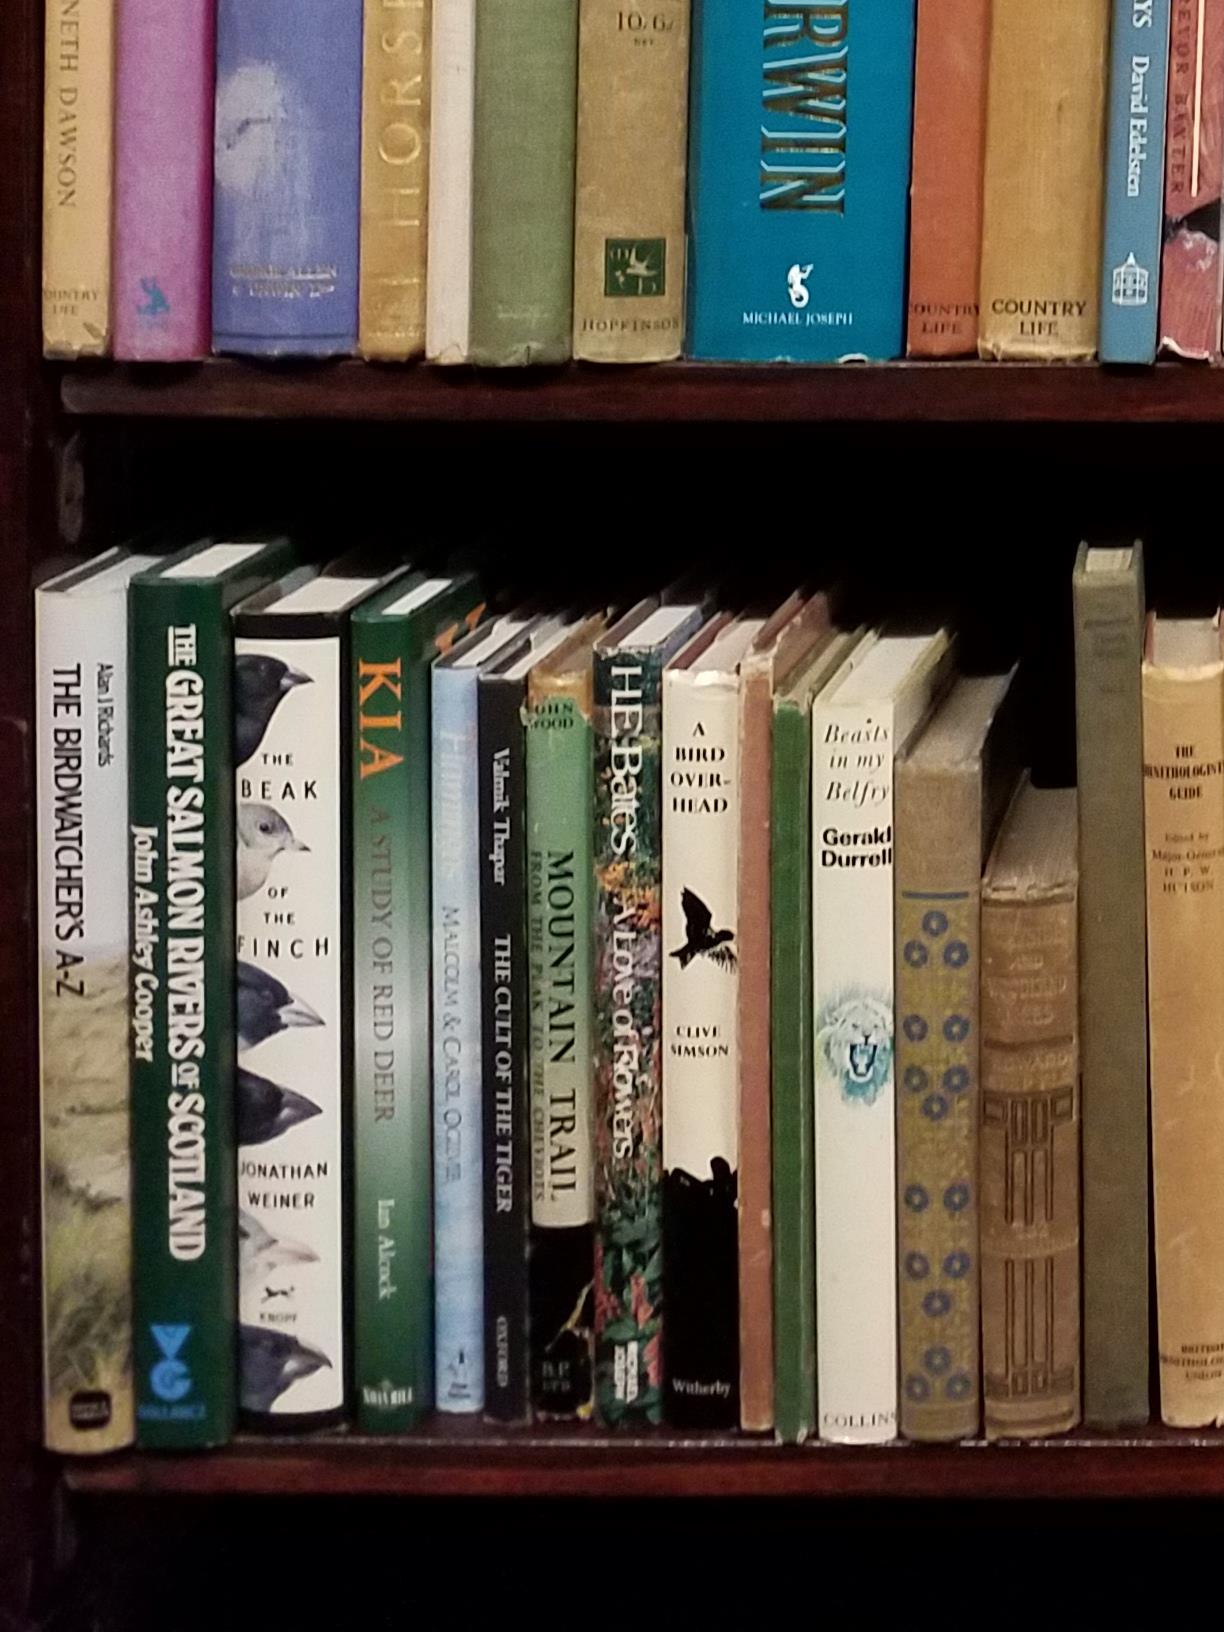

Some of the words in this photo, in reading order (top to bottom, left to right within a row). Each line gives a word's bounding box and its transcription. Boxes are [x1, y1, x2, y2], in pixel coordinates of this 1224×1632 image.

[55, 87, 77, 208] DAWSON
[742, 312, 801, 326] MICHAEL
[805, 312, 853, 326] JOSEPH
[992, 298, 1087, 316] COUNTRY
[1020, 320, 1058, 336] LIFE
[166, 624, 197, 667] THE
[53, 666, 83, 719] THE
[165, 669, 205, 781] GREAT
[358, 657, 404, 780] KIA
[692, 723, 706, 738] A
[823, 723, 890, 745] Beasts
[263, 753, 294, 766] THE
[674, 746, 727, 763] BIRD
[829, 751, 849, 770] in
[857, 753, 887, 771] my
[241, 780, 319, 800] BEAK
[609, 745, 643, 855] Bates
[825, 780, 890, 807] Belfry
[672, 797, 729, 814] HEAD
[53, 727, 86, 941] BIRDWATCHER'S
[822, 827, 893, 846] Gerald
[130, 824, 160, 883] John
[166, 786, 205, 929] SALMON
[821, 849, 893, 867] Durrell
[268, 887, 288, 898] OF
[369, 830, 394, 929] STUDY
[131, 886, 160, 970] Ashley
[264, 913, 296, 924] THE
[237, 939, 330, 958] FINCH
[370, 935, 393, 977] OF
[547, 850, 578, 1067] MOUNTAIN
[54, 948, 85, 997] A-Z
[167, 930, 206, 1061] RIVERS
[132, 972, 156, 1063] Cooper
[373, 984, 394, 1041] RED
[676, 1024, 721, 1038] CLIVE
[670, 1044, 730, 1058] SIMSON
[170, 1063, 205, 1092] OF
[373, 1050, 395, 1124] DEER
[549, 1088, 578, 1196] TRAIL
[168, 1094, 206, 1262] SCOTLAND
[241, 1161, 329, 1180] JONATHAN
[248, 1192, 316, 1209] WEINER
[672, 1379, 731, 1398] Witherby
